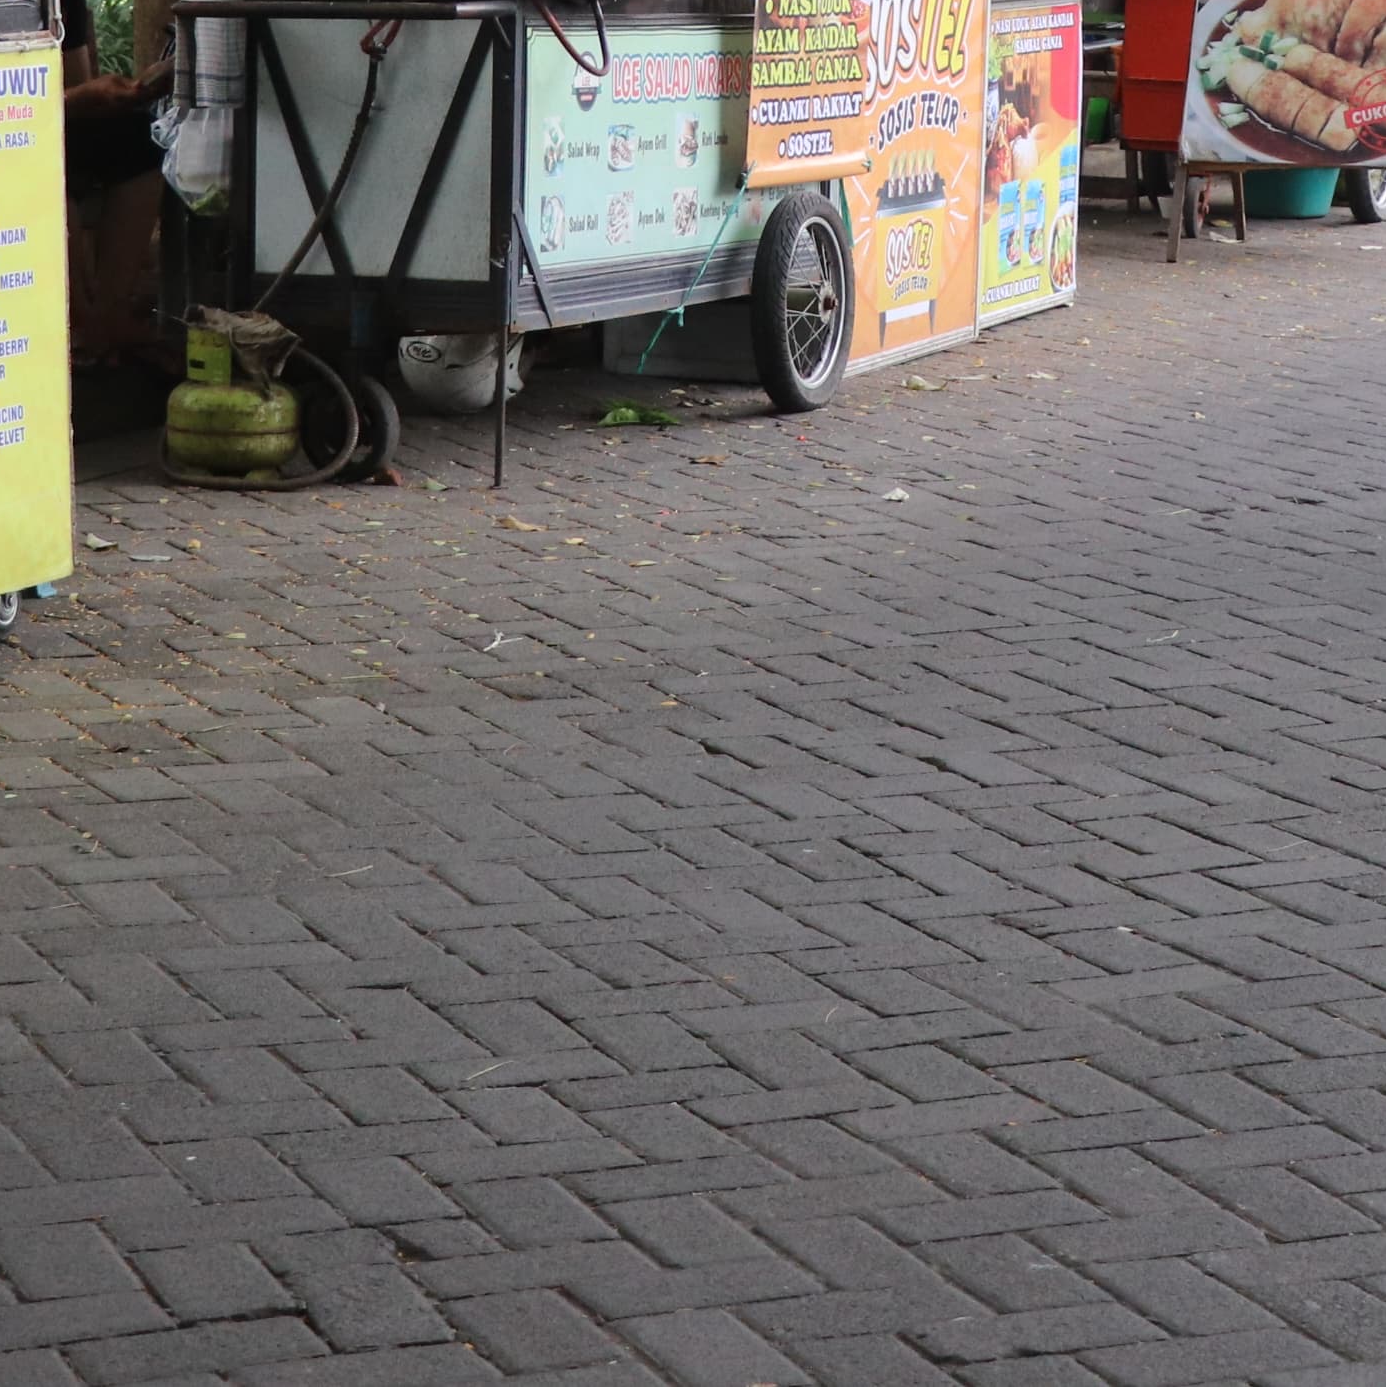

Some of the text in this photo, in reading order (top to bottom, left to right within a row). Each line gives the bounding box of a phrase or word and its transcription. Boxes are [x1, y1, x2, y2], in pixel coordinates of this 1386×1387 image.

[756, 24, 858, 53] AYAM KANDAR
[613, 57, 641, 98] LGE
[644, 56, 691, 98] SALAD
[695, 55, 741, 97] WRAPS
[752, 56, 861, 86] SAMBAL GANJA
[7, 105, 33, 119] Muda
[759, 93, 863, 123] CUANKI RAKYAT
[879, 93, 958, 150] SOSIS TELOR
[568, 143, 600, 159] Salad Wrap
[638, 137, 652, 153] Ayam
[788, 131, 833, 156] SOSTEL
[569, 218, 585, 232] Salad
[886, 219, 932, 285] SOSTEL
